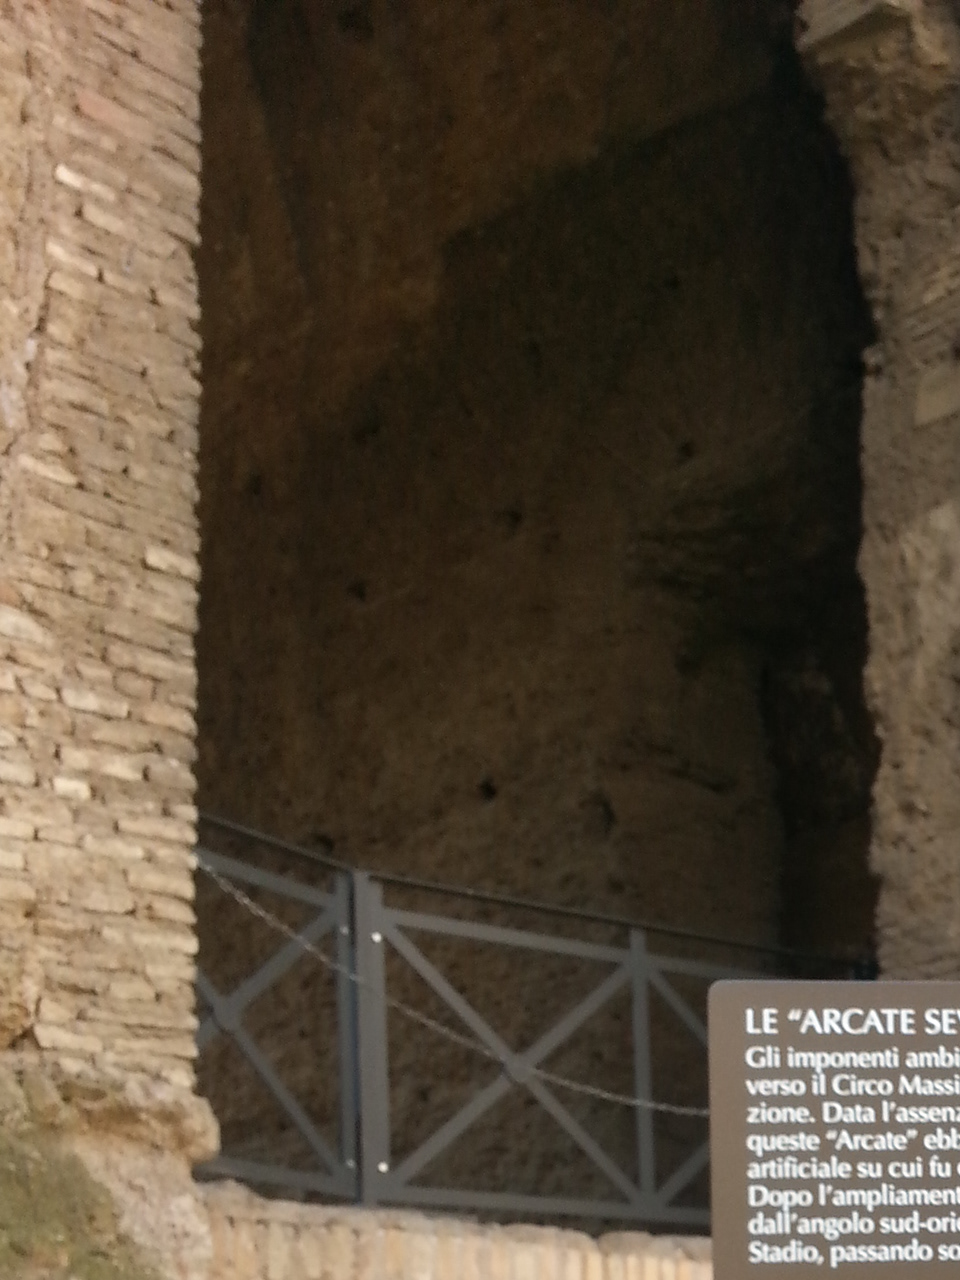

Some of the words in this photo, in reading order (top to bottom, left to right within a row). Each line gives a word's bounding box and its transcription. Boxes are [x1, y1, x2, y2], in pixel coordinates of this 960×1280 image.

[745, 1008, 778, 1035] LE
[787, 1008, 915, 1035] “ARCATE
[745, 1046, 780, 1068] Gli
[787, 1046, 899, 1073] imponenti
[745, 1079, 806, 1096] verso
[811, 1073, 825, 1095] il
[831, 1073, 893, 1095] Circo
[746, 1101, 815, 1123] zione.
[822, 1101, 875, 1123] Data
[746, 1132, 820, 1156] queste
[825, 1128, 917, 1151] “Arcate”
[746, 1156, 852, 1179] artificiale
[856, 1162, 882, 1178] su
[887, 1156, 922, 1178] cui
[929, 1156, 951, 1178] fu
[748, 1184, 813, 1212] Dopo
[747, 1212, 874, 1240] dall’angolo
[748, 1240, 823, 1265] Stadio,
[830, 1239, 933, 1267] passando
